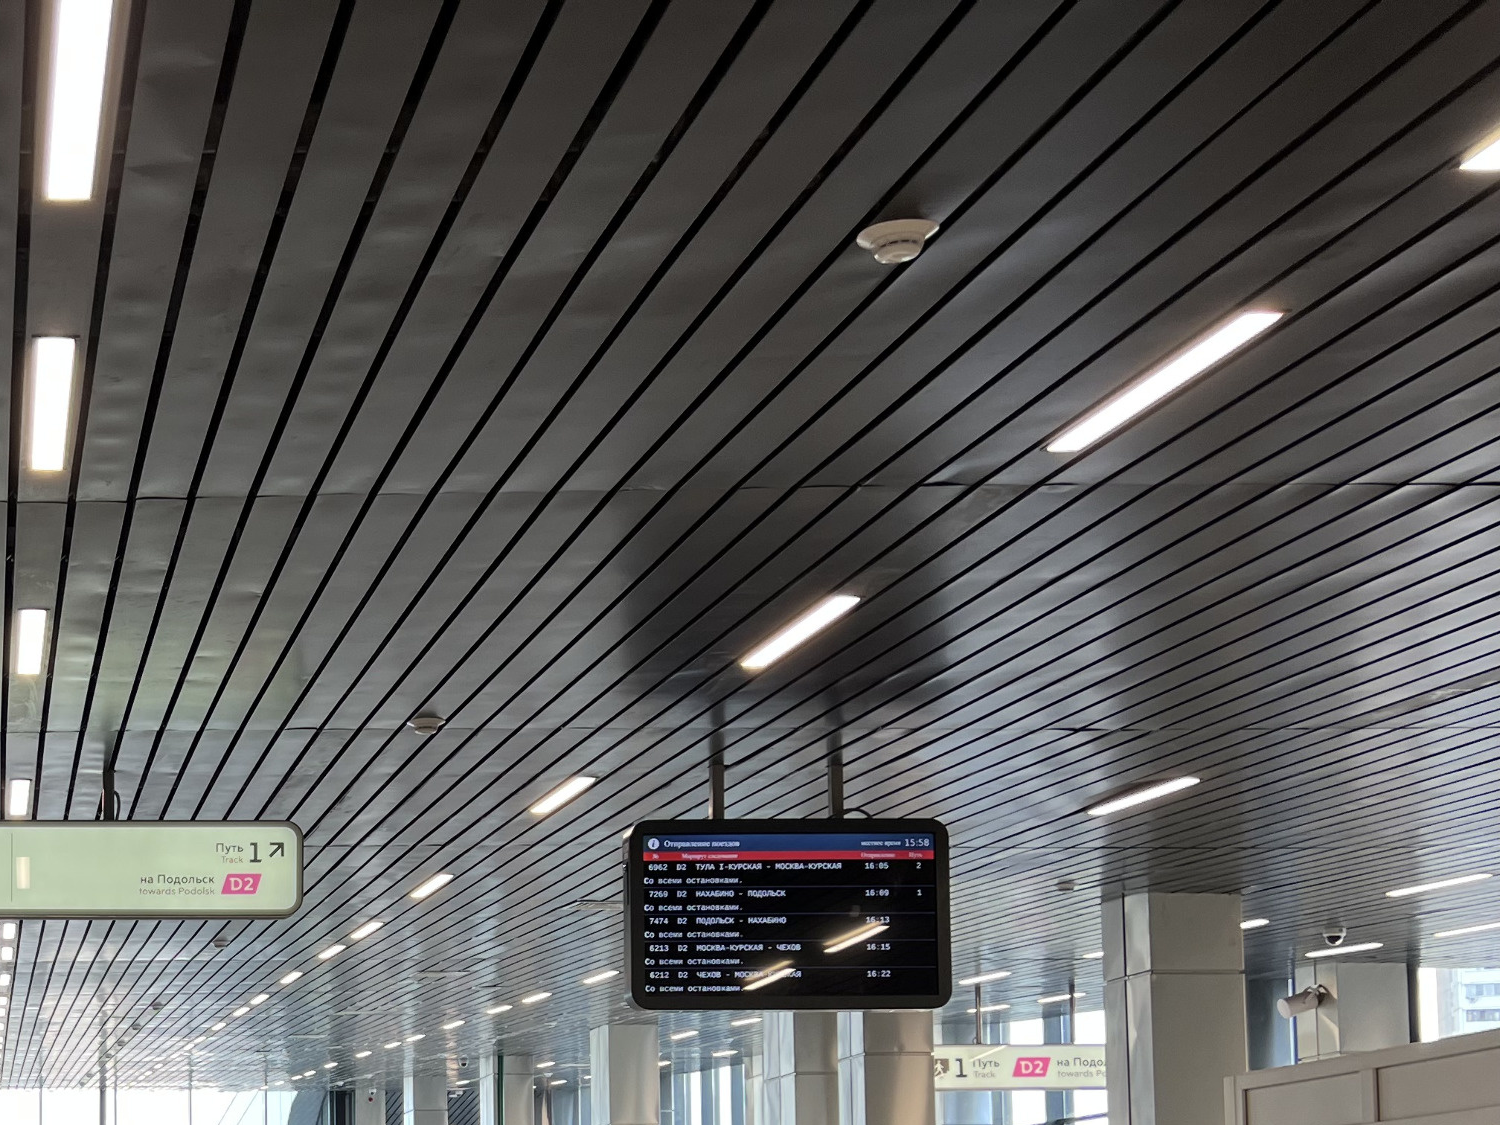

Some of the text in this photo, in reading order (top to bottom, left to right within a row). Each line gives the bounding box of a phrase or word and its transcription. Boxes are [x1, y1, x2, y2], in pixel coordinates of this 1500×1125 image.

[664, 840, 711, 849] Отправление
[904, 839, 930, 847] 15:58
[215, 842, 244, 855] Путь
[249, 842, 262, 863] 1
[221, 855, 244, 864] Track
[676, 863, 687, 871] D2
[695, 863, 715, 871] ТУЛА
[775, 862, 842, 870] МОСКВА-КУРСКАЯ
[865, 862, 889, 870] 16:05
[140, 874, 215, 885] на Подольск
[643, 877, 654, 885] Со
[229, 877, 254, 891] D2
[139, 887, 215, 896] towards Podolsk
[649, 890, 668, 898] 7269
[677, 890, 687, 898] D2
[747, 890, 786, 898] ПОДОЛЬСК
[644, 904, 655, 912] Со
[649, 917, 669, 925] 7474
[677, 917, 688, 925] D2
[696, 917, 735, 925] ПОДОЛЬСК
[644, 931, 655, 939] Со
[649, 944, 669, 952] 6213
[677, 944, 688, 952] D2
[696, 944, 764, 952] МОСКВА-КУРСКАЯ
[866, 943, 891, 951] 16:15
[644, 958, 655, 966] Со
[649, 971, 670, 979] 6212
[678, 971, 689, 979] D2
[867, 970, 891, 978] 16:22
[645, 985, 656, 993] Со
[972, 1058, 1000, 1069] Путь
[1020, 1060, 1044, 1074] D2
[1056, 1059, 1071, 1067] на
[955, 1058, 968, 1078] 1
[973, 1071, 996, 1079] Track
[1057, 1070, 1094, 1078] towards
